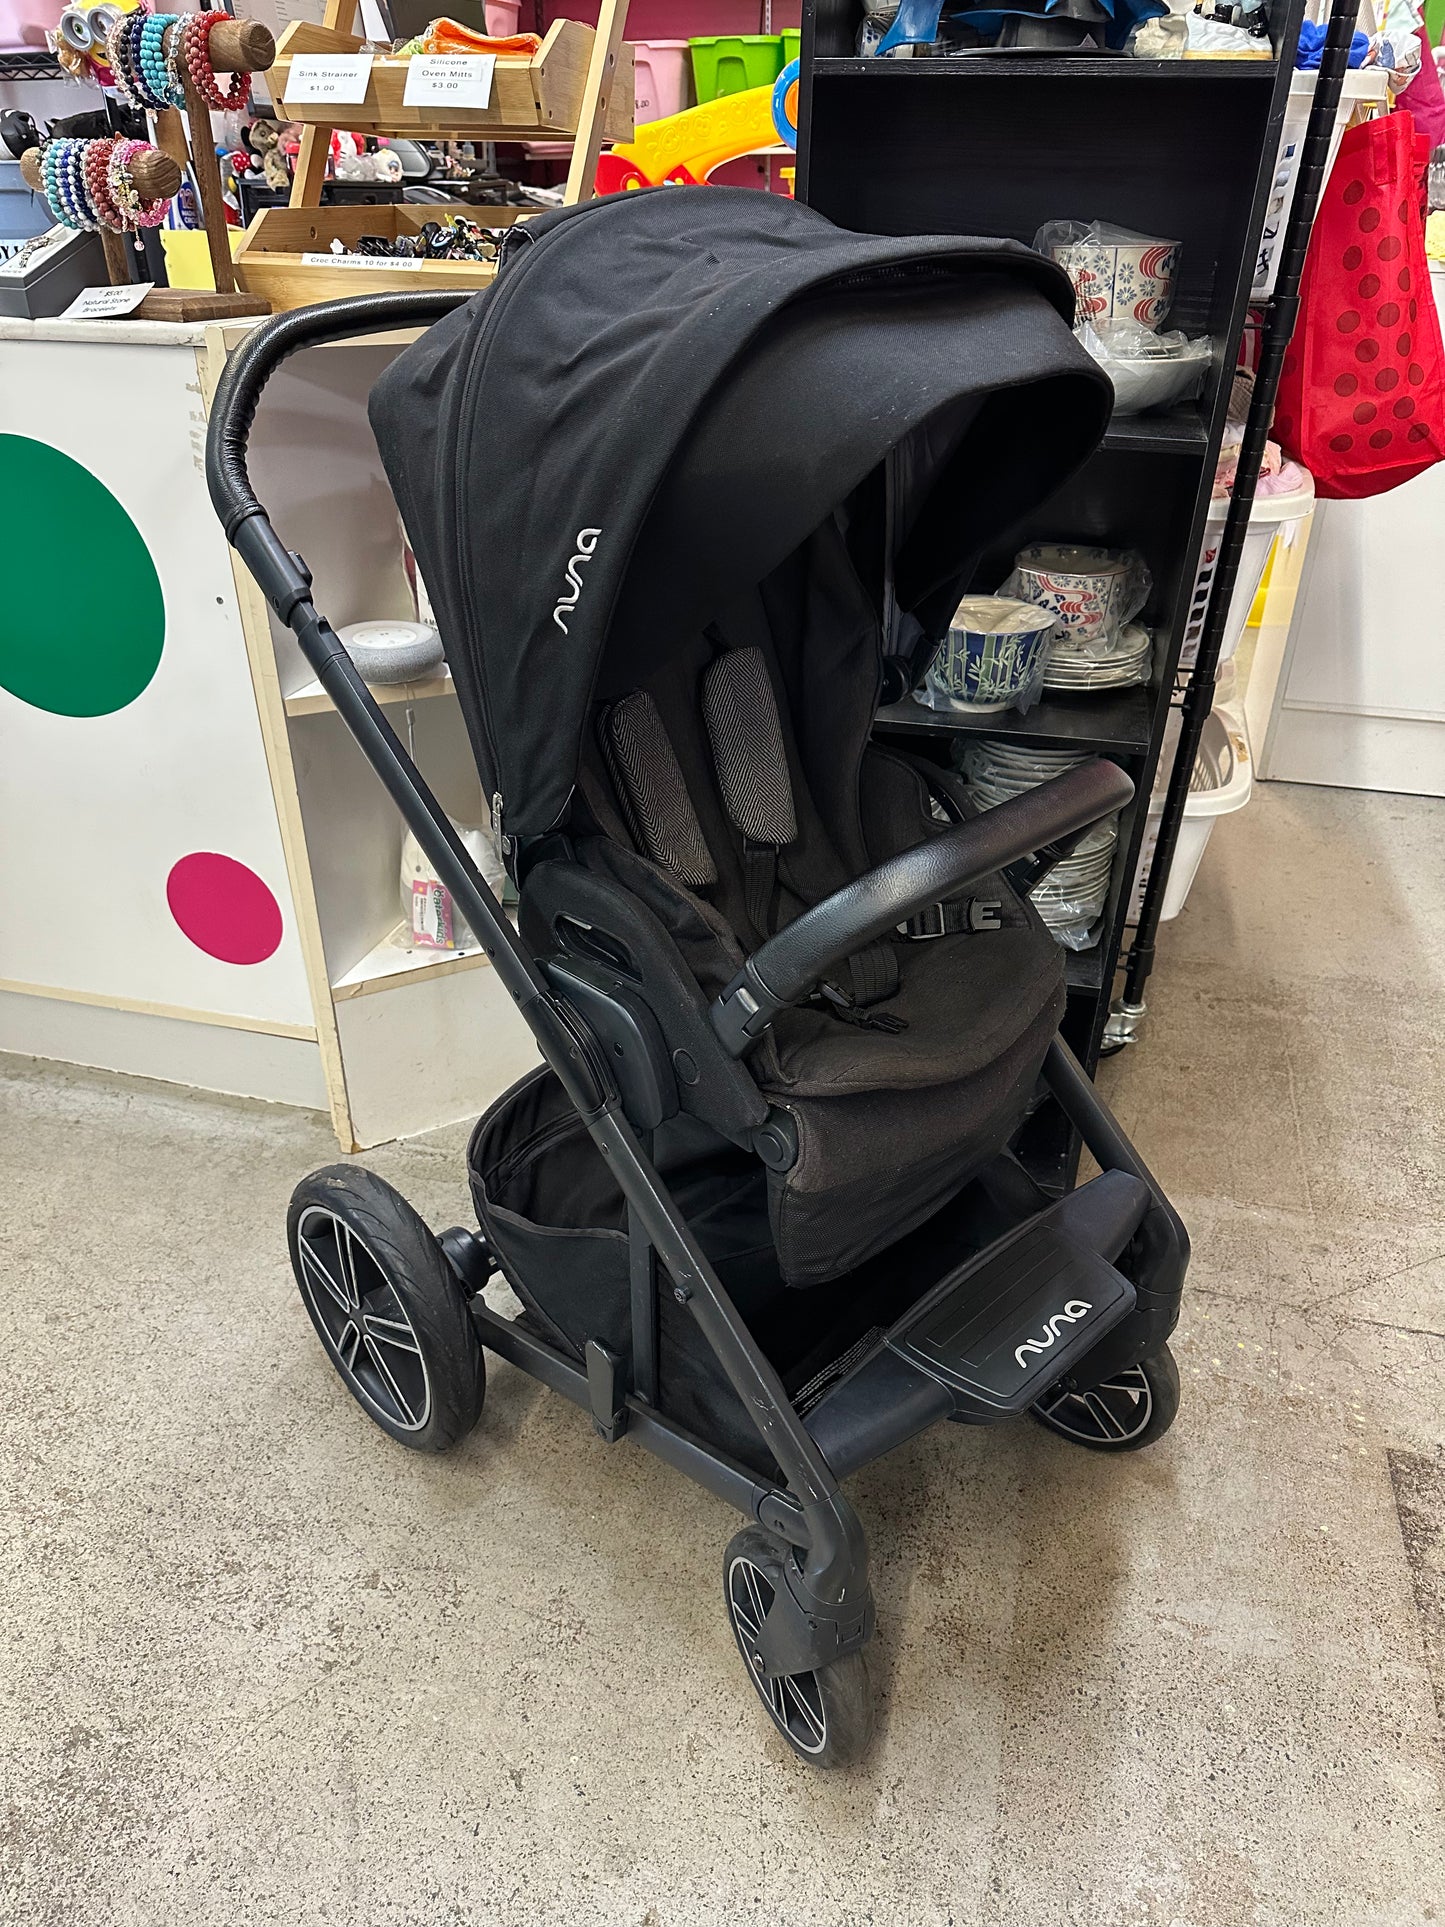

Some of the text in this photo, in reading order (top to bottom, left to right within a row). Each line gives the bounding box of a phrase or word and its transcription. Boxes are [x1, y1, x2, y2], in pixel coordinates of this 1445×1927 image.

[376, 259, 387, 267] for
[553, 528, 602, 635] nuna
[1014, 1300, 1093, 1368] nuna
